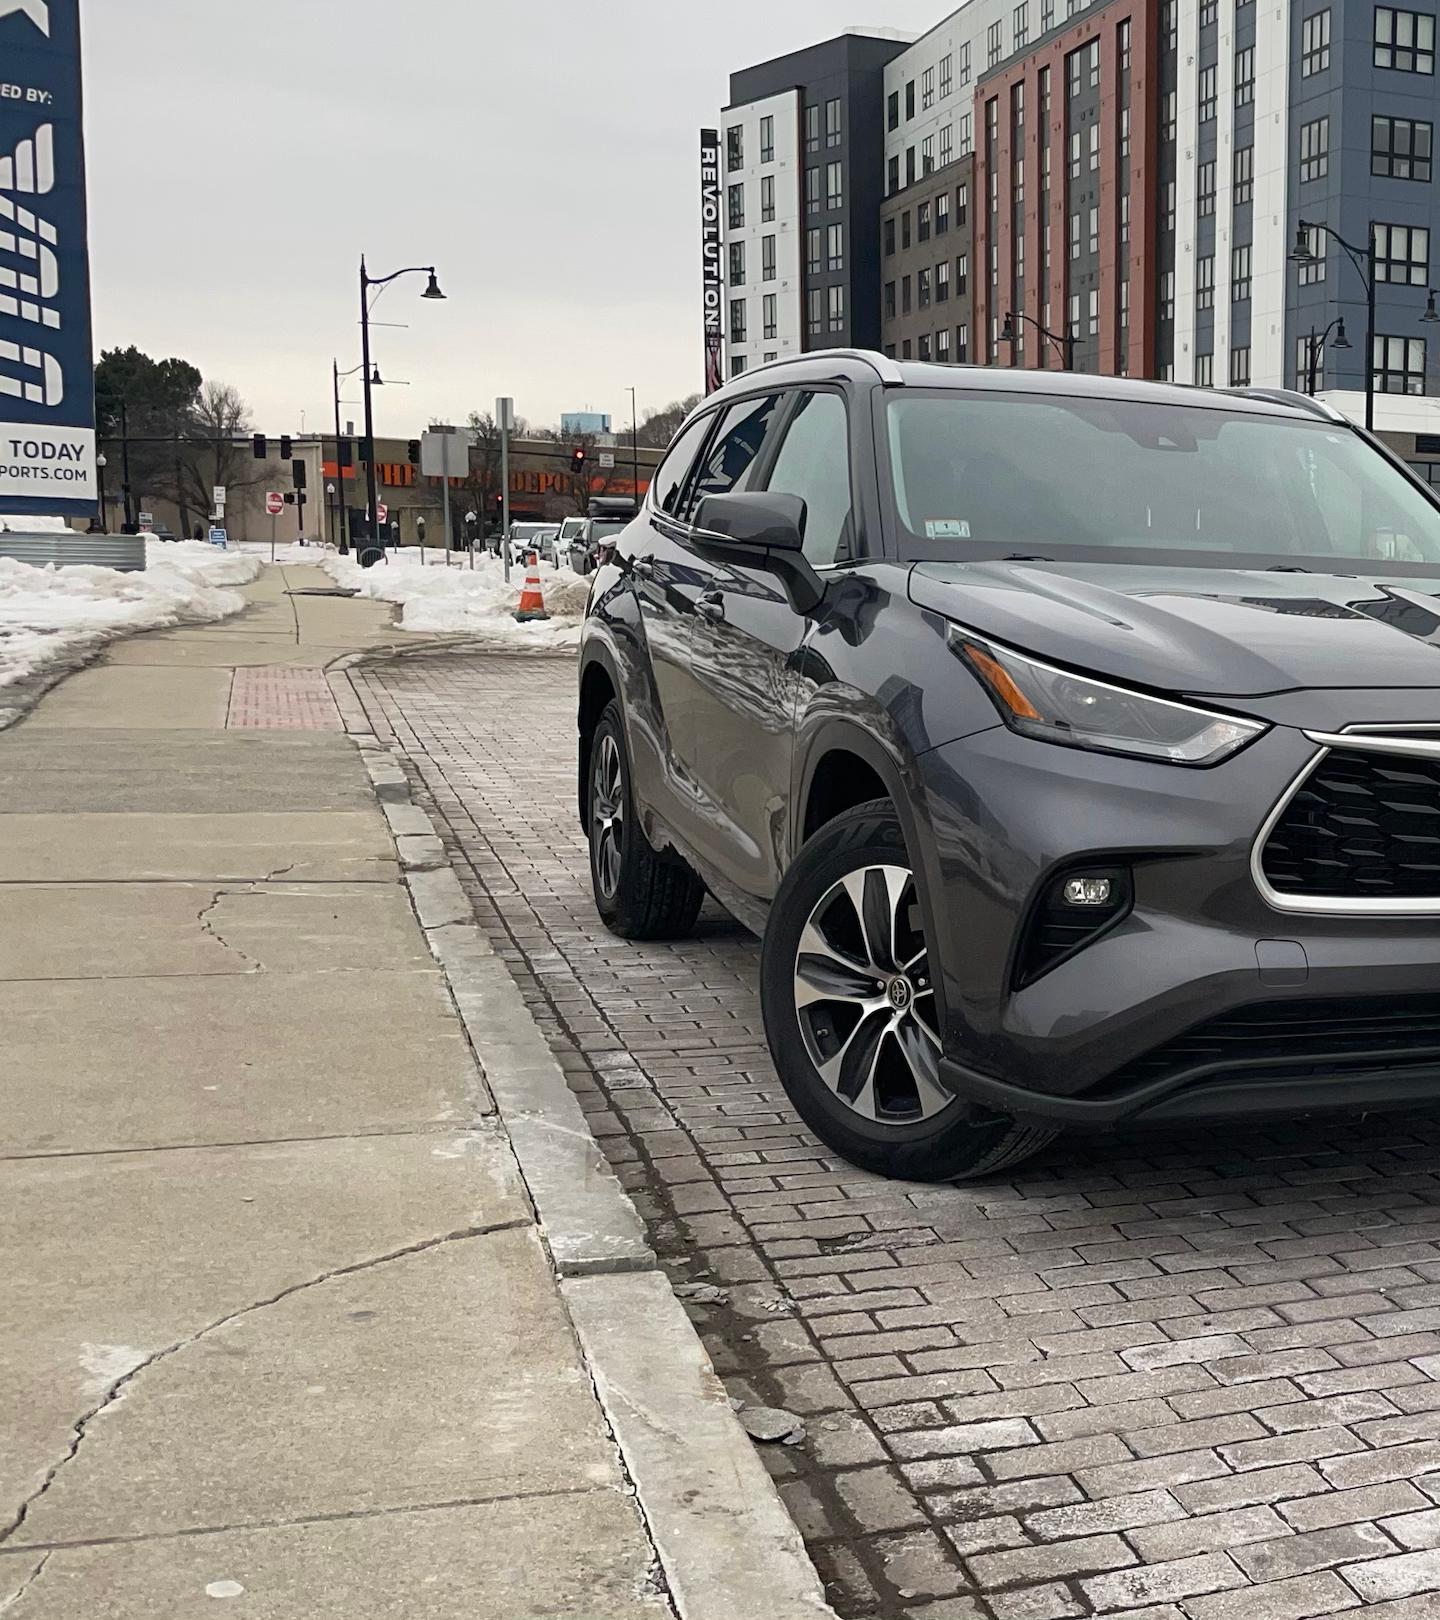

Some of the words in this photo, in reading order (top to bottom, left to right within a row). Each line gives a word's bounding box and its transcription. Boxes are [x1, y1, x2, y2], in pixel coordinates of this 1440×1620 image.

[26, 87, 52, 104] BY:
[702, 147, 719, 327] REVOLUTION
[8, 440, 85, 461] TODAY
